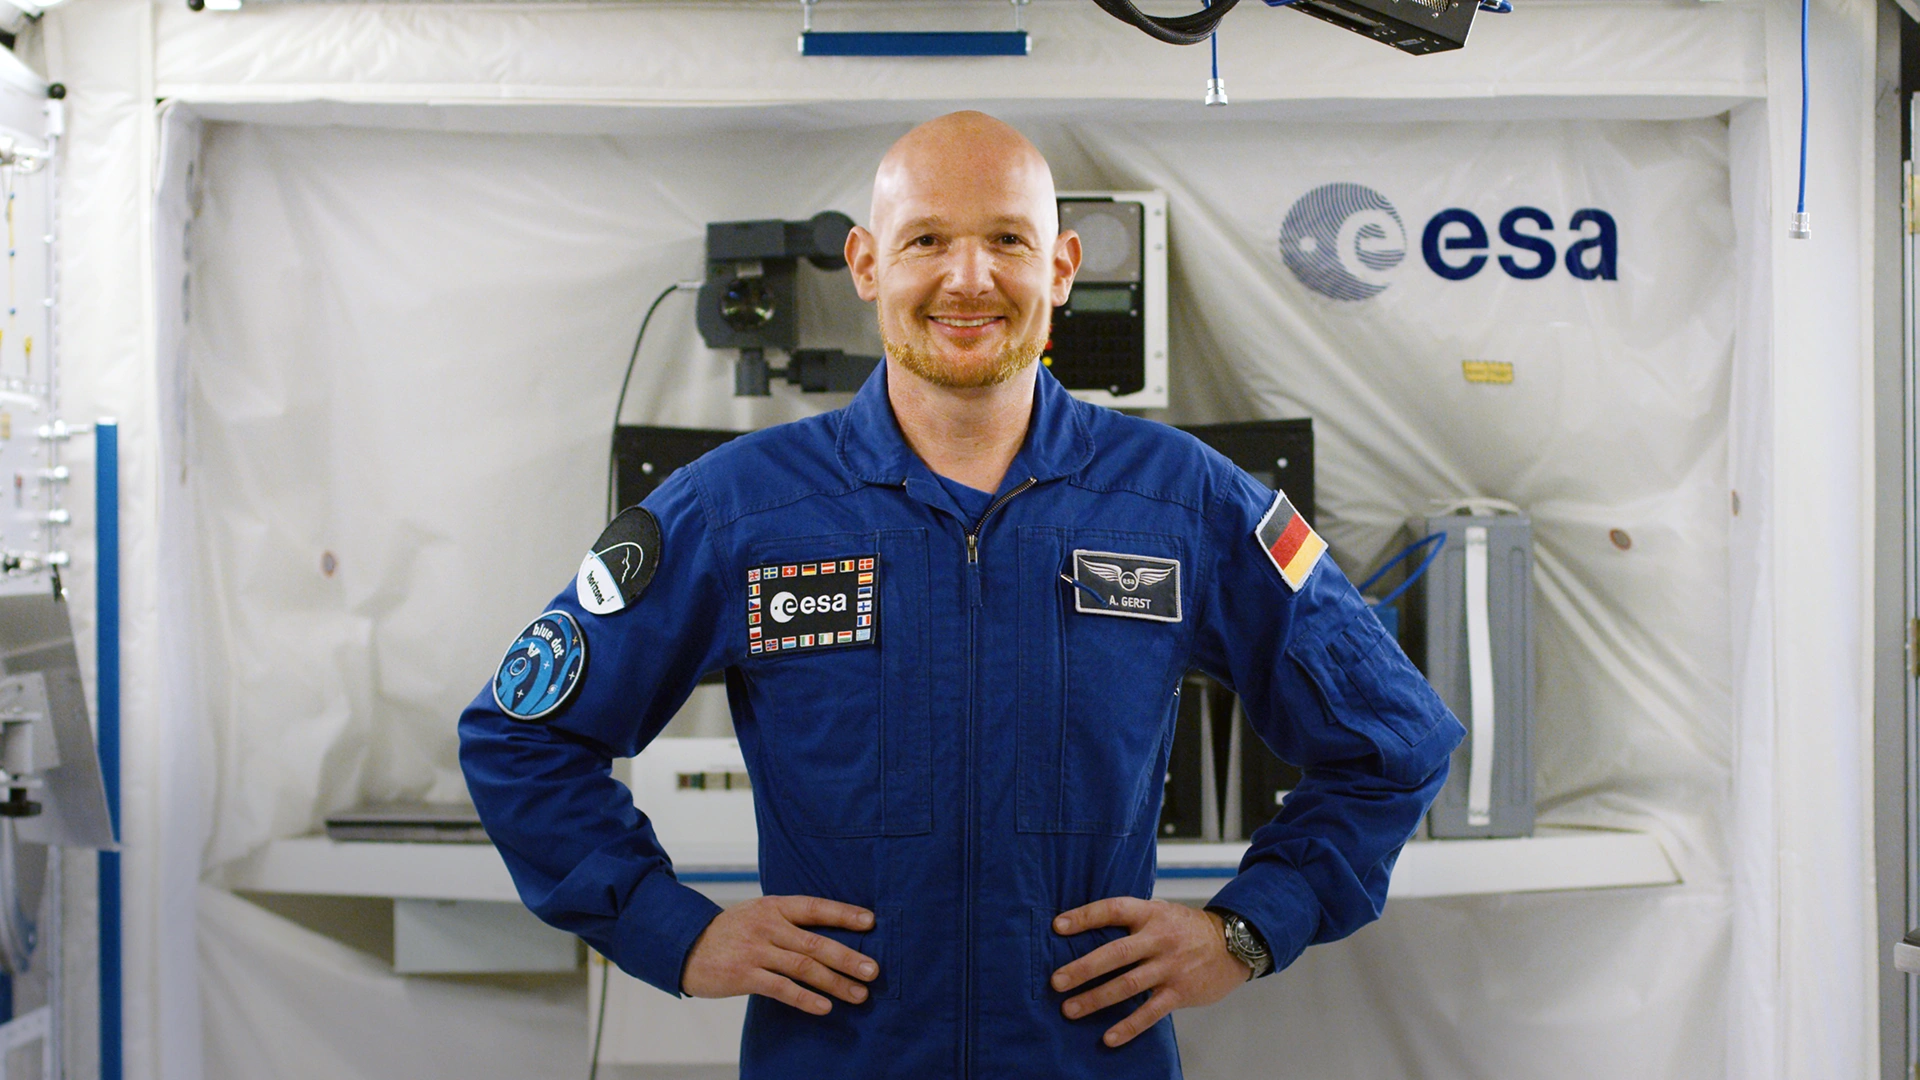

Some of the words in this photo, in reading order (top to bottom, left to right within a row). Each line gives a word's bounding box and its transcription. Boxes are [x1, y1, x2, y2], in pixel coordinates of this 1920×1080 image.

[1421, 206, 1618, 281] esa
[586, 570, 605, 606] horizons
[800, 593, 847, 615] esa
[1109, 595, 1119, 606] A.
[1121, 596, 1152, 609] GERST
[532, 623, 553, 641] blue
[551, 638, 565, 659] dot
